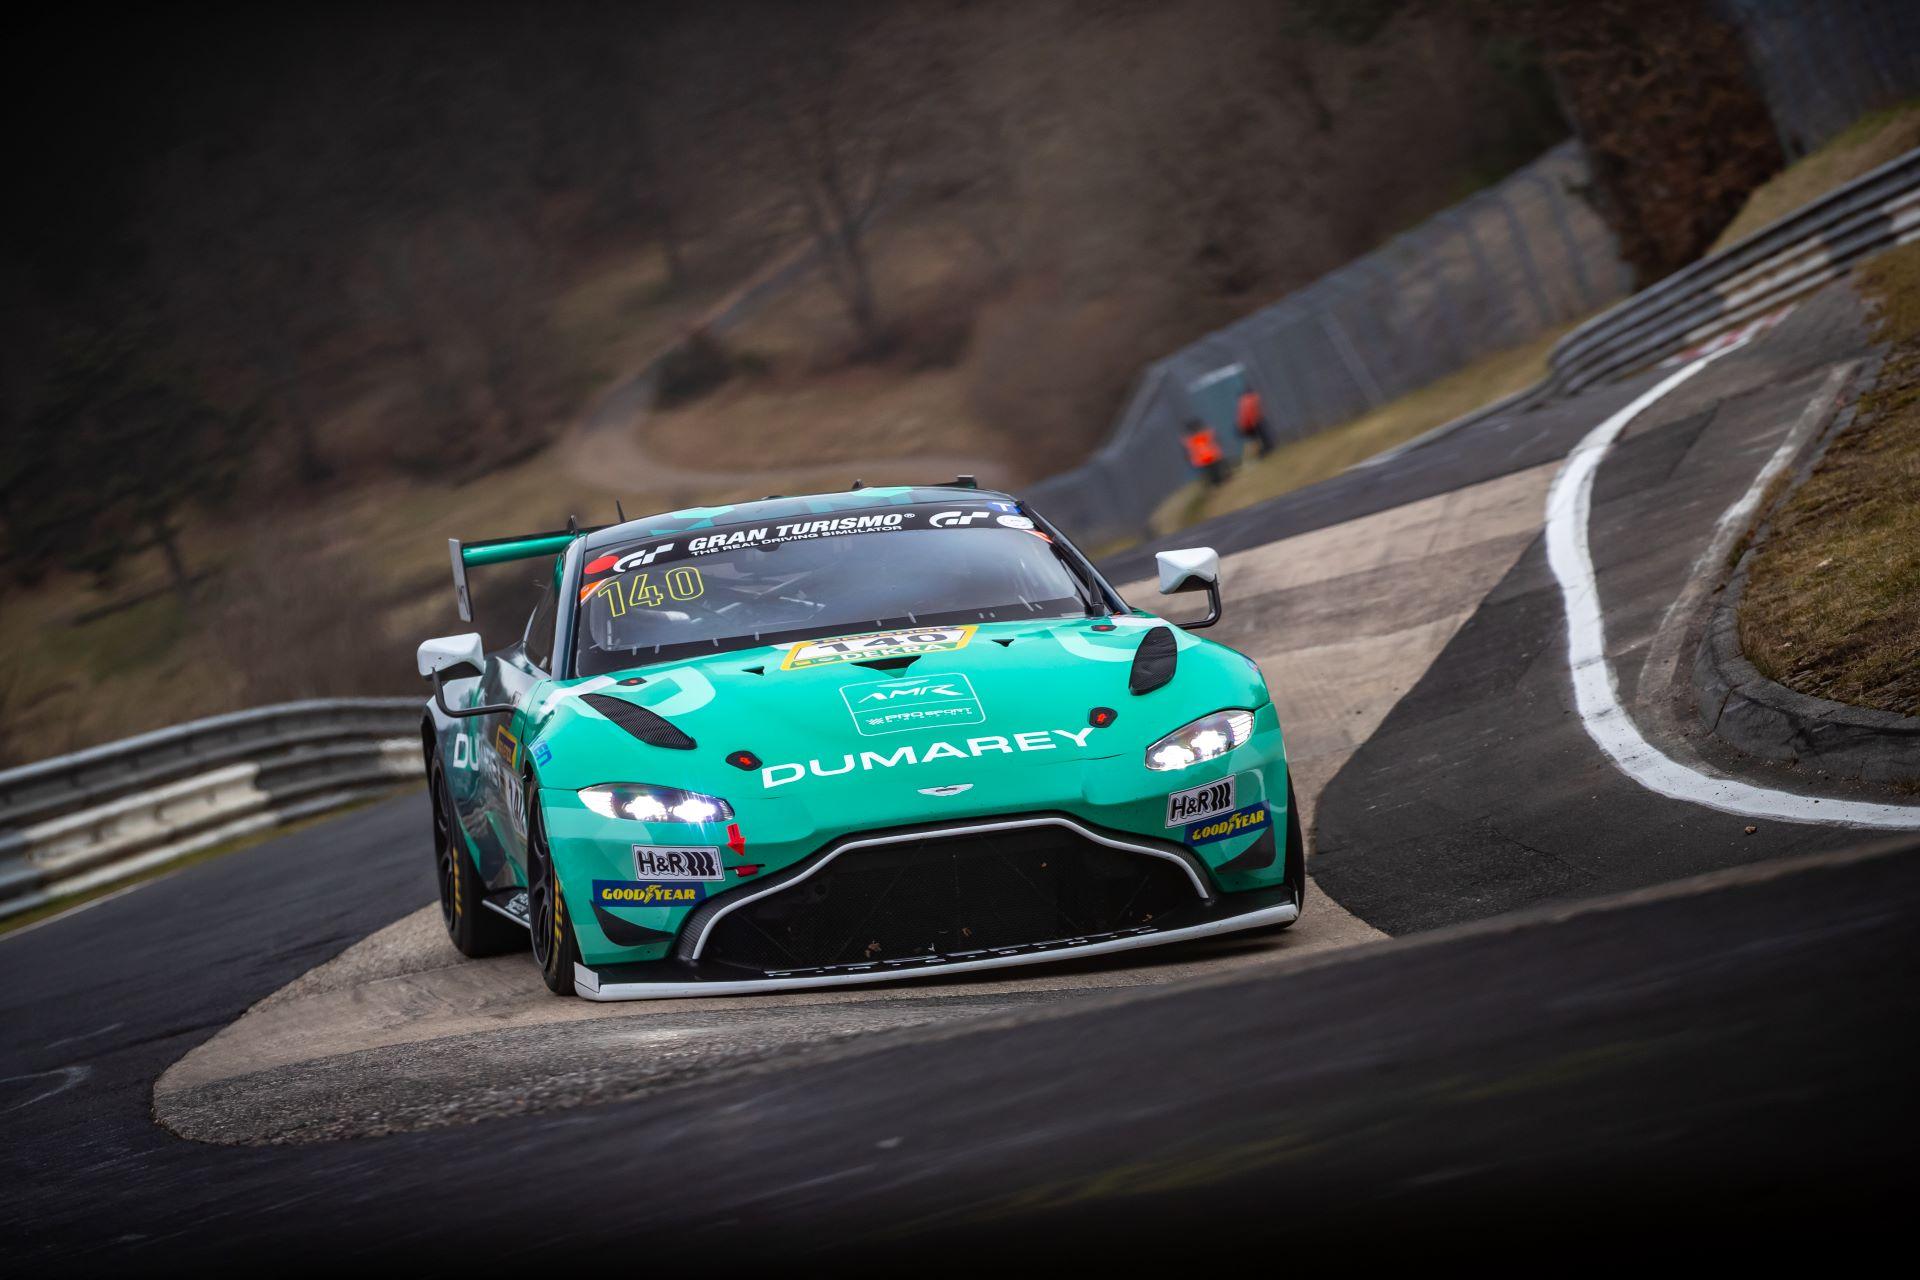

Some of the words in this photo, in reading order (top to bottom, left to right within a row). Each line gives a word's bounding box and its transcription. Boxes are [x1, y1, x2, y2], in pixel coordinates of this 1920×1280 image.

[688, 527, 768, 552] GRAN
[690, 547, 719, 556] THE
[723, 541, 759, 551] REAL
[762, 532, 818, 545] DRIVING
[821, 525, 902, 537] SIMULATOR
[598, 566, 704, 617] 140
[819, 633, 948, 652] 140
[840, 643, 946, 660] DEKRA
[761, 728, 1095, 788] DUMAREY
[1171, 791, 1208, 820] H&R
[637, 850, 684, 874] H&R
